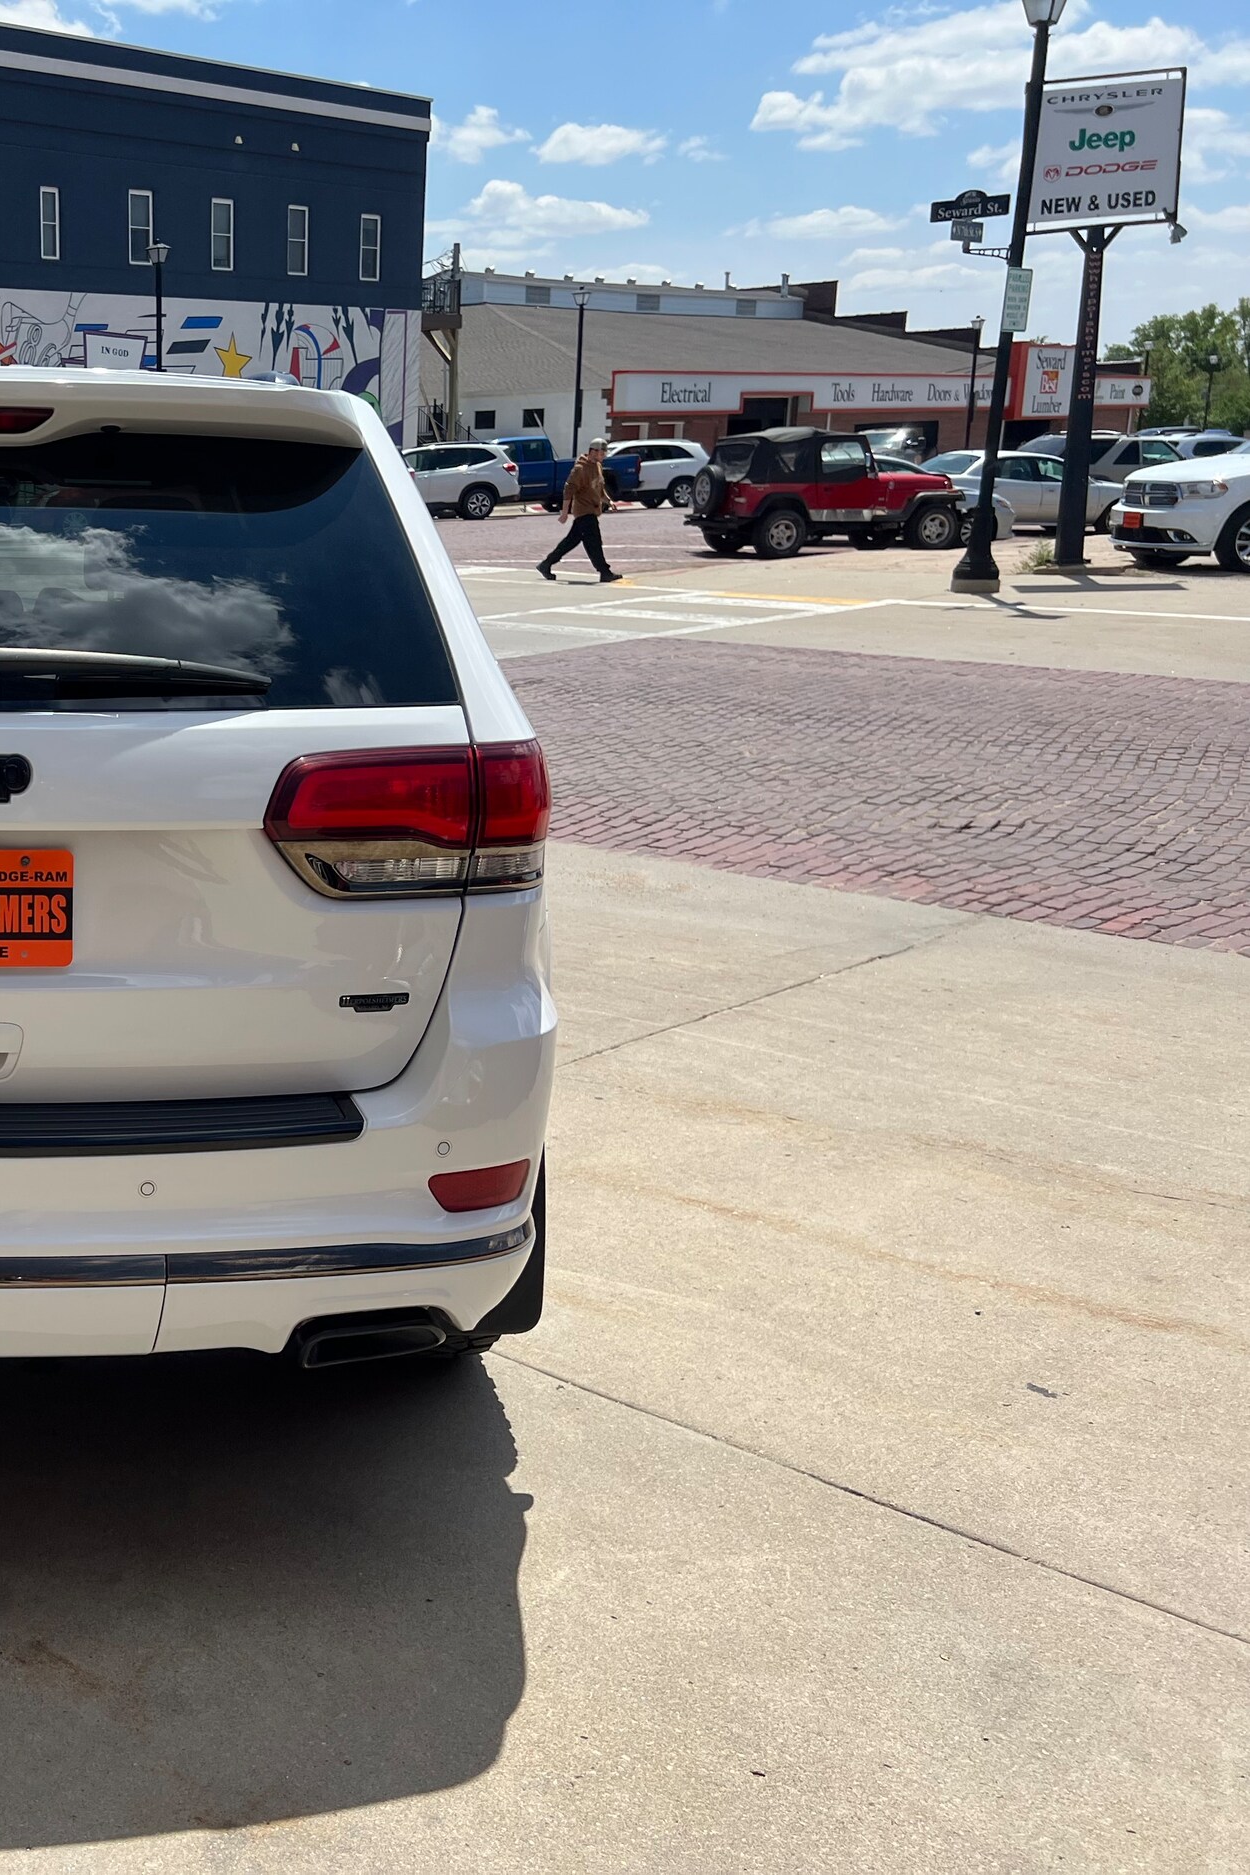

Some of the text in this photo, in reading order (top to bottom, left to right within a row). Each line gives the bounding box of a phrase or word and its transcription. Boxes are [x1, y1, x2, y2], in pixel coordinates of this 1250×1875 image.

[1047, 88, 1163, 104] CHRYSLER
[1069, 128, 1136, 152] Jeep
[1065, 160, 1158, 177] DODGE
[937, 201, 1003, 219] Seward St.
[1041, 190, 1156, 215] NEW & USED
[101, 345, 129, 357] IN GOD
[1036, 349, 1067, 370] Seward
[661, 382, 711, 403] Electrical
[832, 382, 855, 402] Tools
[871, 383, 914, 402] Hardware
[927, 383, 951, 401] Doors
[1041, 374, 1057, 393] Best
[1031, 395, 1062, 414] Lumber
